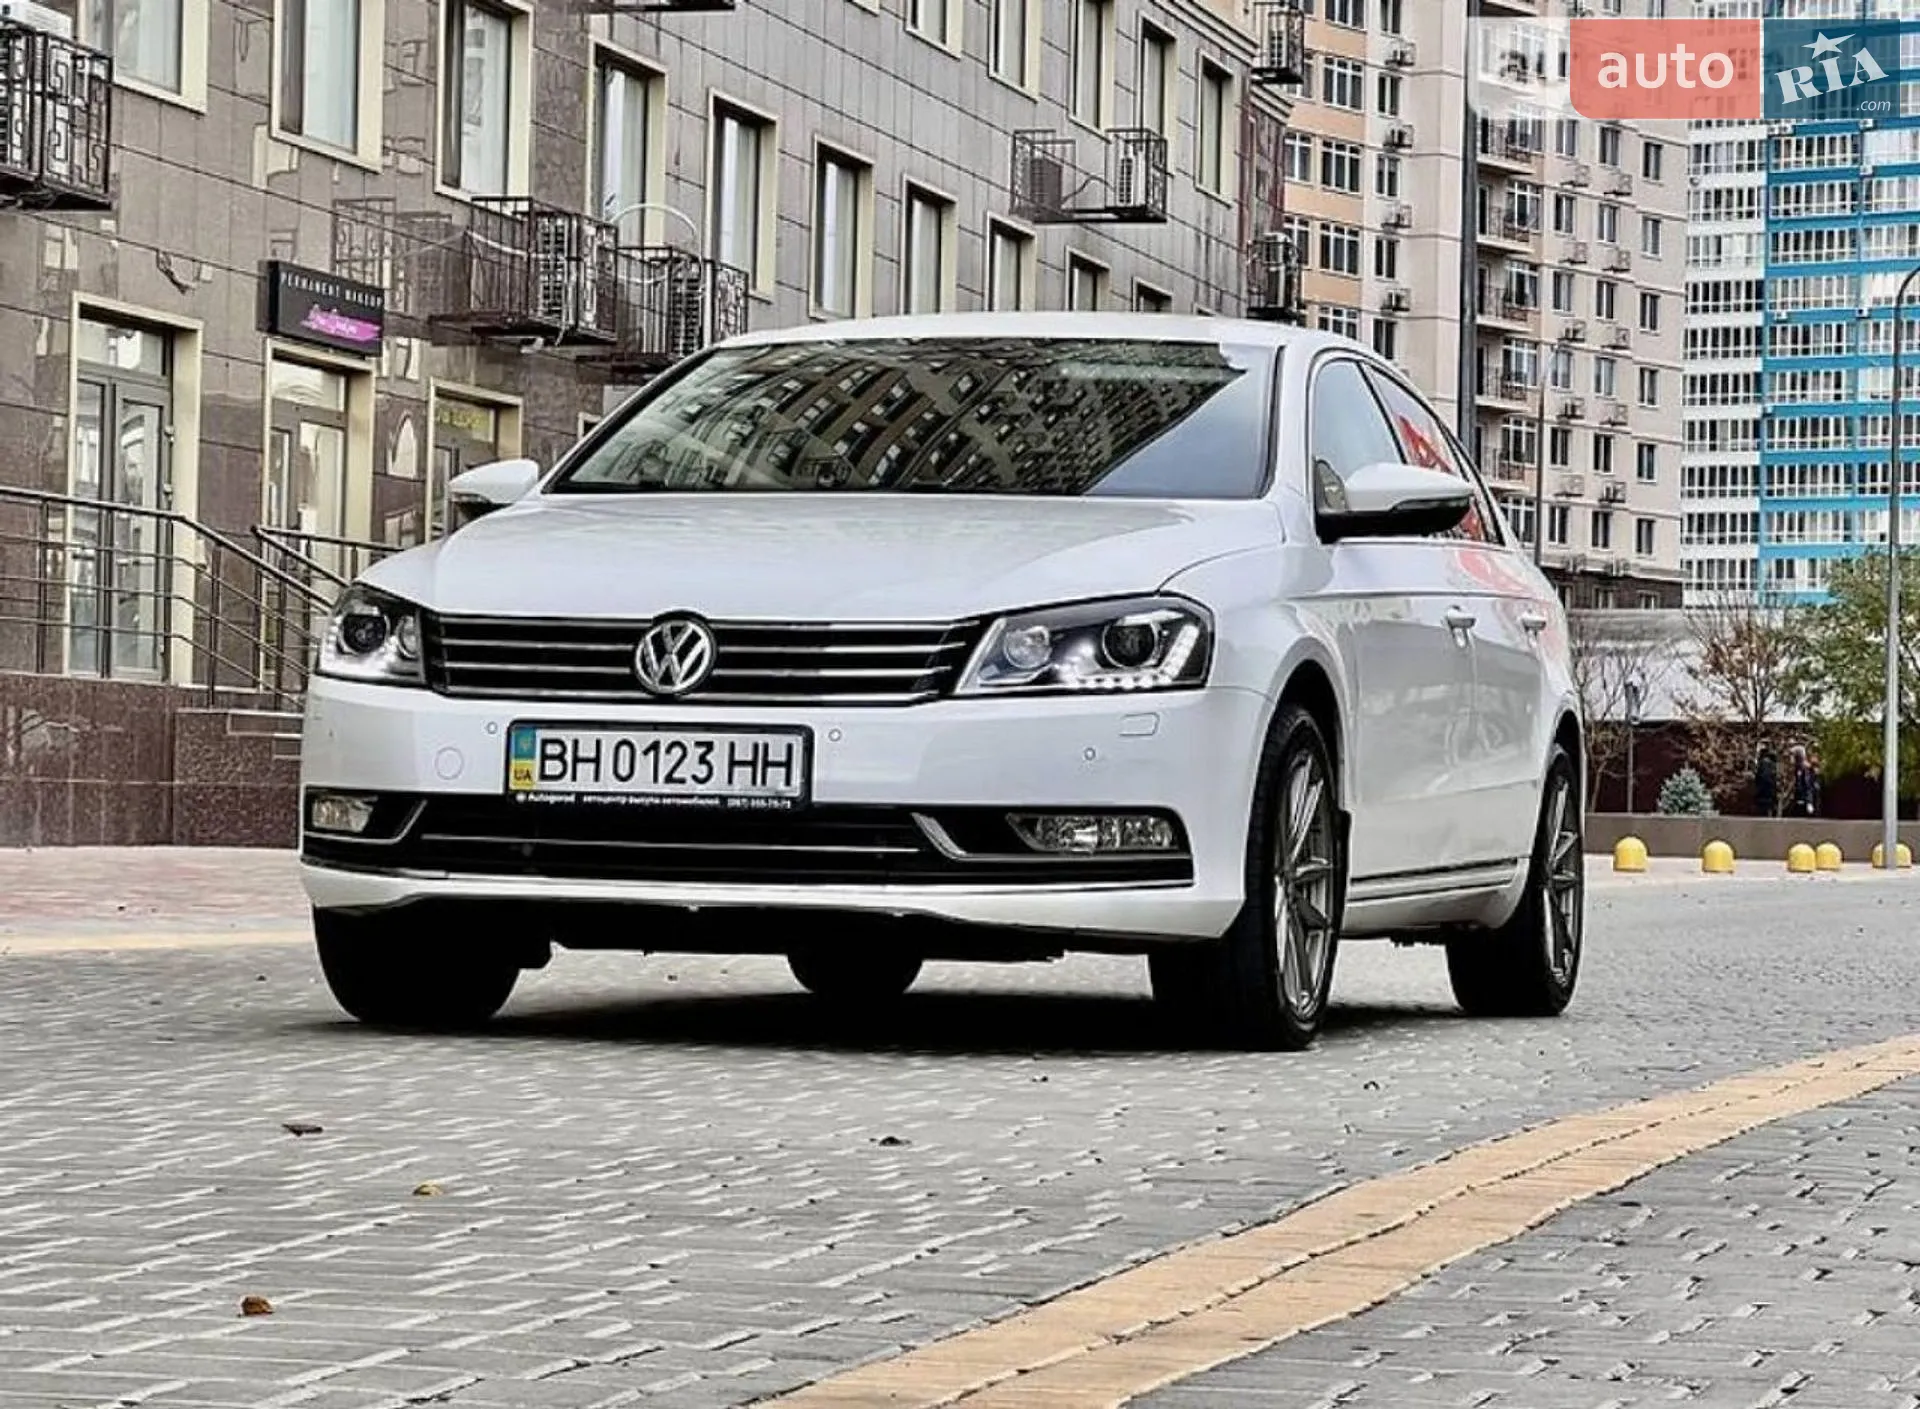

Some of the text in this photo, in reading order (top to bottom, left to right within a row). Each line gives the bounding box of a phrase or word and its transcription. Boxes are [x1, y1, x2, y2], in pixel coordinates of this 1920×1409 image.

[513, 769, 532, 782] UA
[538, 738, 794, 787] BH 0123 HH
